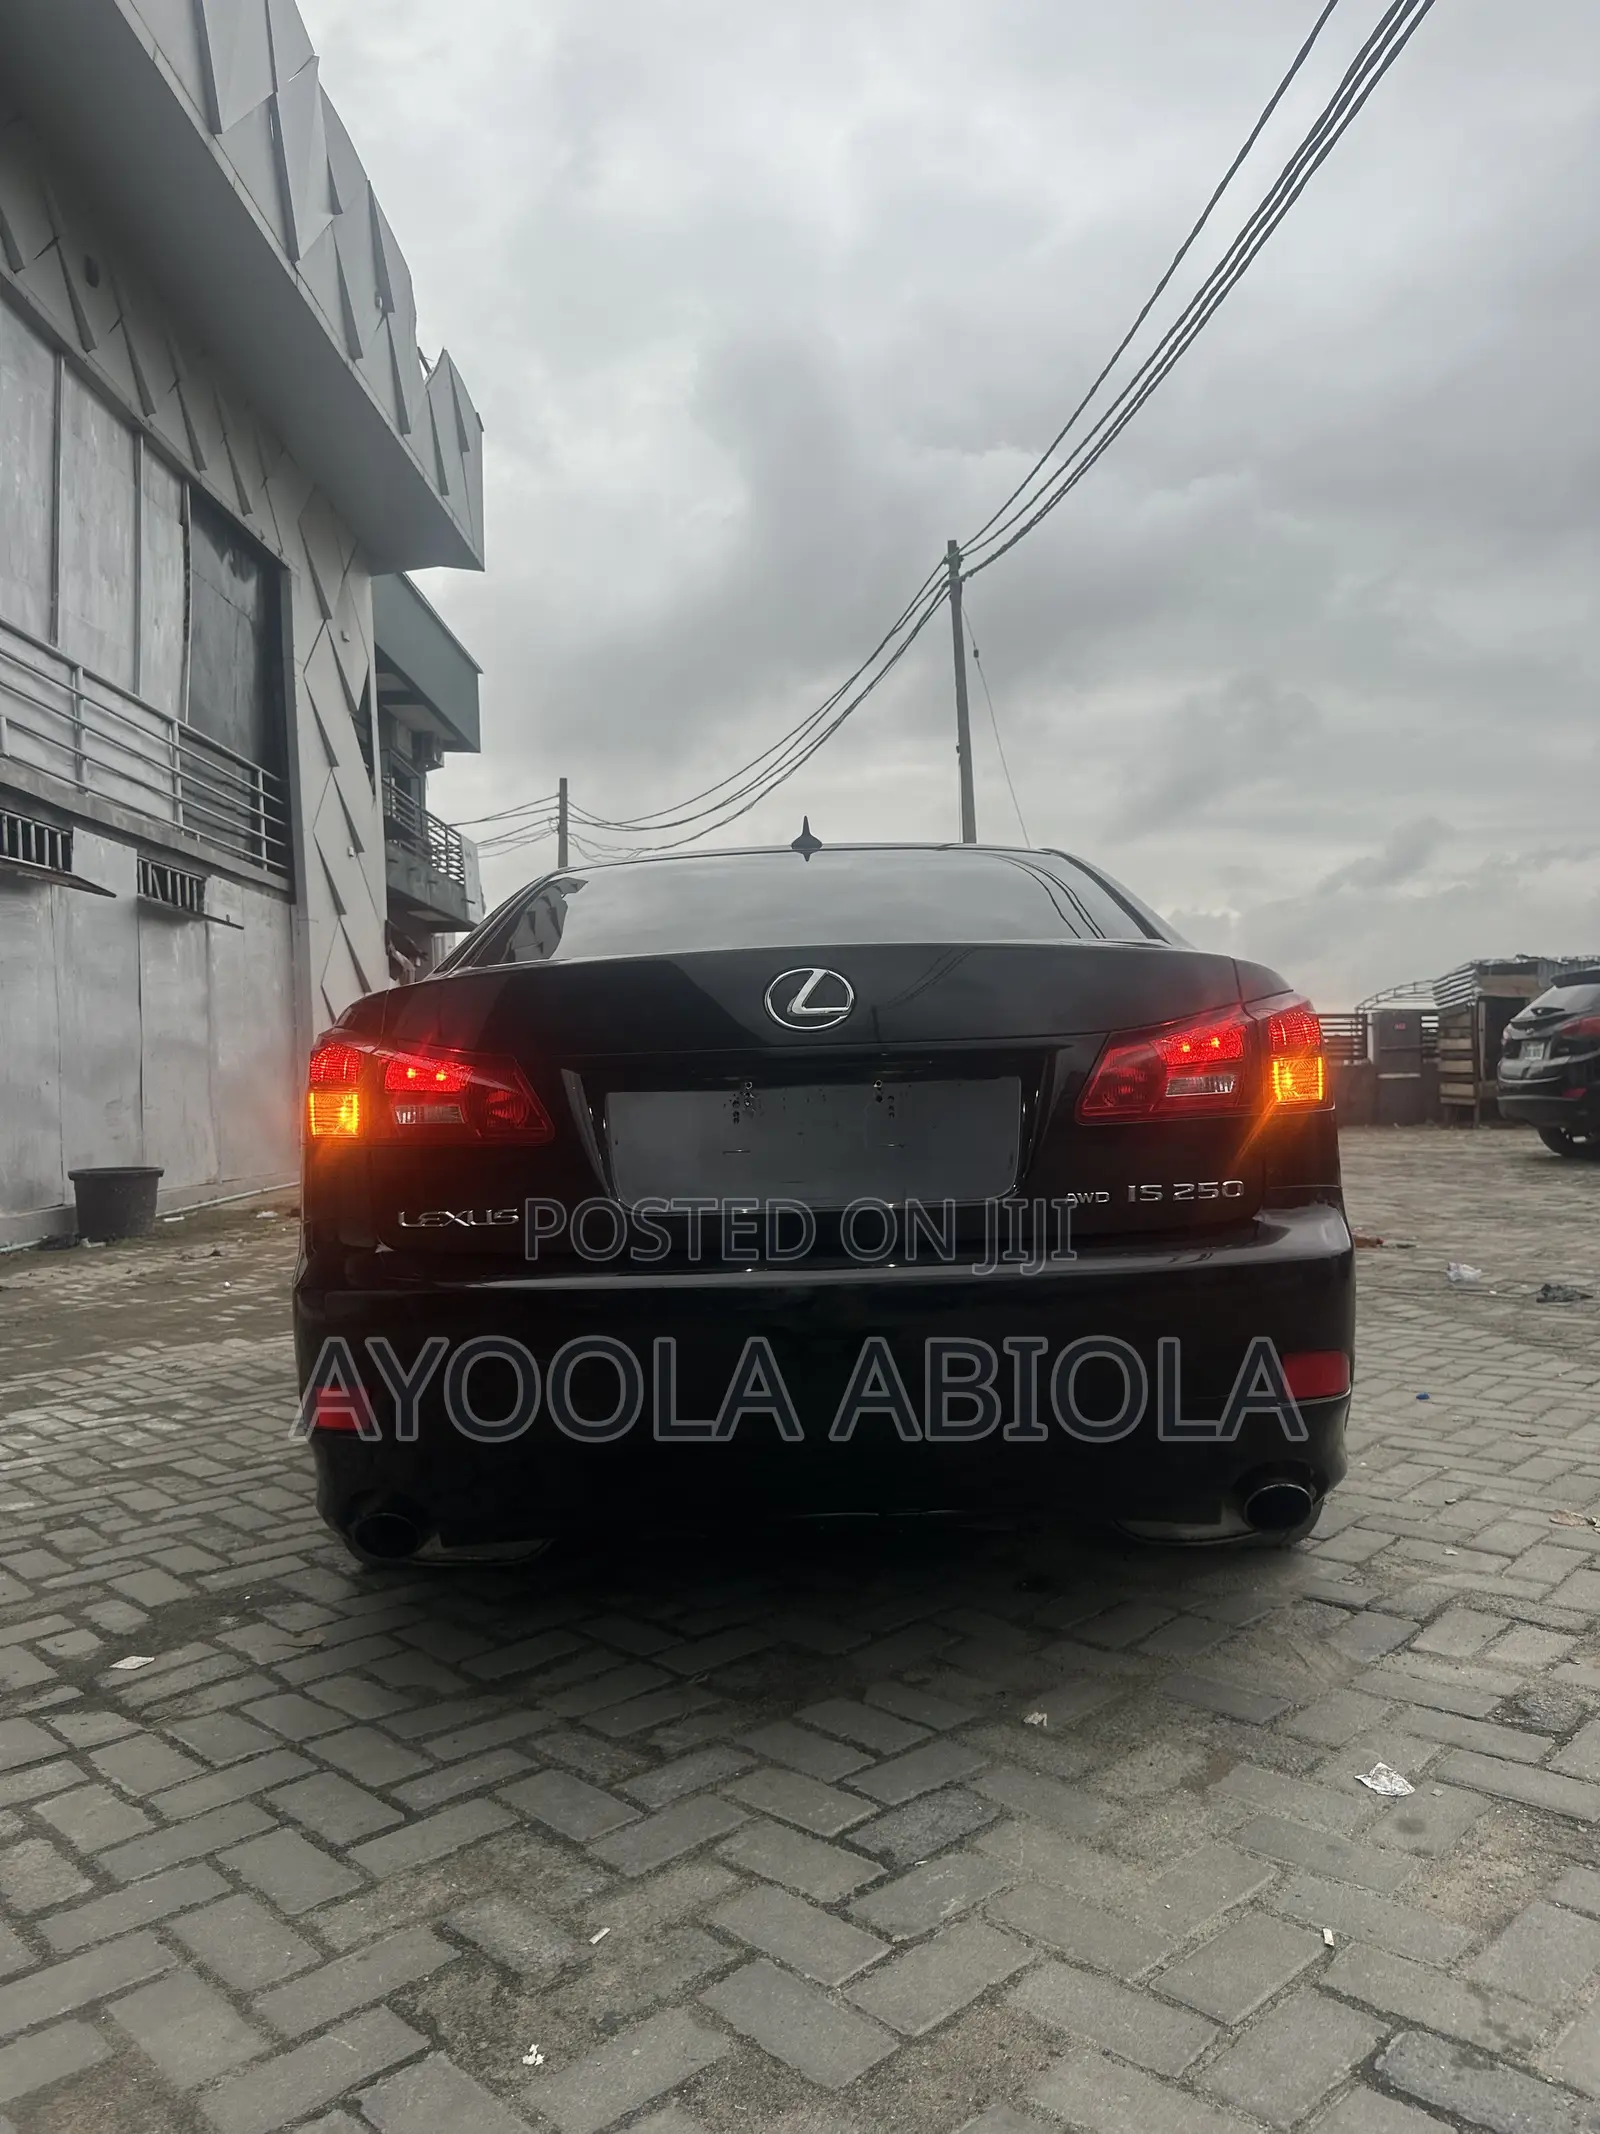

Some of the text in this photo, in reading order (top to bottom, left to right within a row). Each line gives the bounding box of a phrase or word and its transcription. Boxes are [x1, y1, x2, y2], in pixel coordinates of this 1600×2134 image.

[1066, 1191, 1110, 1204] AWD
[1127, 1180, 1245, 1203] IS 250
[398, 1208, 519, 1227] LEXUS
